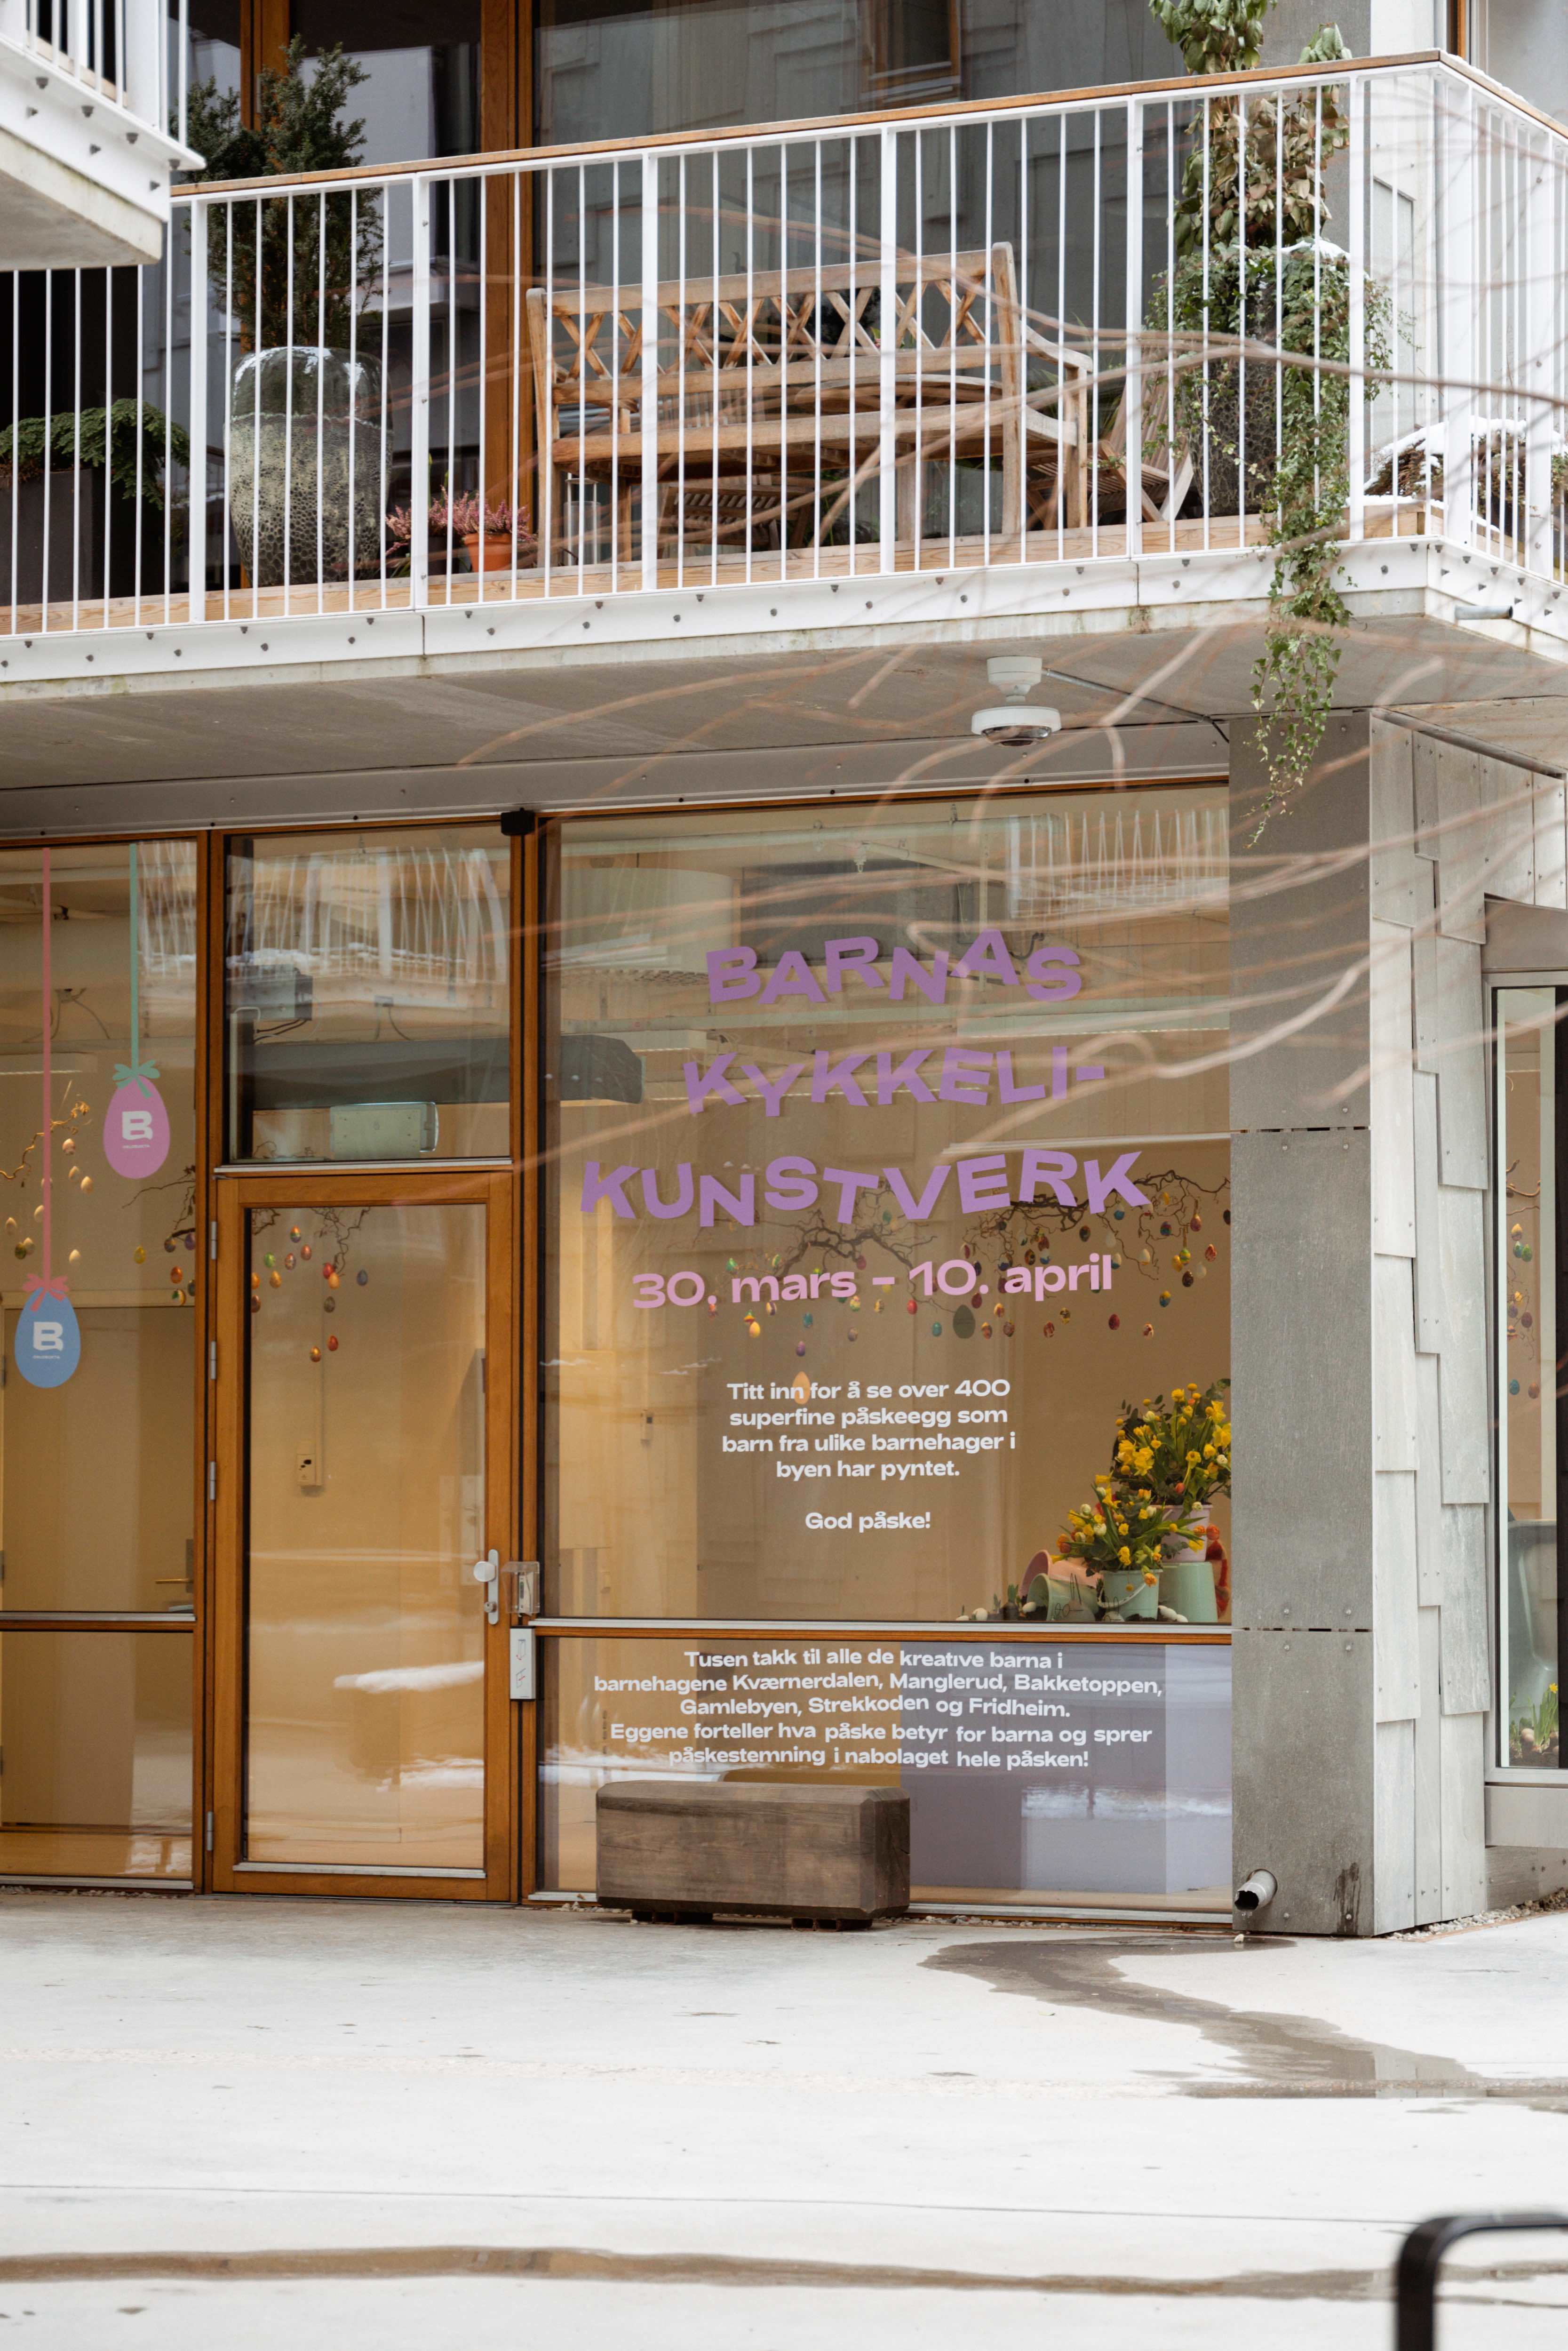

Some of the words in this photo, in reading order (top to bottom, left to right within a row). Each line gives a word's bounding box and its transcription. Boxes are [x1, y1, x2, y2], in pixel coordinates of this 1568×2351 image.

[705, 928, 1082, 1005] BARNAS
[683, 1046, 1105, 1116] KYKKELI-
[121, 1111, 153, 1140] B
[580, 1149, 1153, 1226] KUNSTVERK
[632, 1272, 716, 1309] 30.
[732, 1268, 857, 1303] mars
[908, 1259, 989, 1297] 10.
[1003, 1254, 1113, 1301] april
[32, 1321, 64, 1351] B
[727, 1383, 764, 1399] Titt
[771, 1382, 804, 1399] inn
[810, 1382, 841, 1399] for
[847, 1381, 860, 1399] å
[867, 1384, 892, 1398] se
[899, 1383, 949, 1398] over
[955, 1379, 1011, 1397] 400
[730, 1408, 835, 1430] superfine
[842, 1407, 951, 1428] påskeegg
[957, 1409, 1007, 1423] som
[722, 1436, 772, 1452] barn
[779, 1436, 809, 1452] fra
[814, 1433, 866, 1452] ulike
[872, 1432, 1004, 1454] barnehager
[1010, 1431, 1015, 1449] i
[777, 1461, 831, 1481] byen
[837, 1461, 875, 1477] har
[881, 1461, 960, 1480] pyntet.
[805, 1512, 852, 1529] God
[859, 1511, 931, 1533] påske!
[685, 1651, 748, 1667] Tusen
[753, 1649, 797, 1666] takk
[803, 1648, 820, 1664] til
[827, 1648, 862, 1664] alle
[868, 1648, 893, 1664] de
[990, 1652, 1051, 1668] barna
[1058, 1652, 1063, 1668] i
[594, 1676, 727, 1695] barnehagene
[733, 1672, 883, 1690] Kværnerdalen,
[890, 1674, 1007, 1693] Manglerud,
[1015, 1674, 1162, 1696] Bakketoppen,
[680, 1699, 803, 1717] Gamlebyen,
[808, 1695, 929, 1713] Strekkoden
[936, 1703, 963, 1717] og
[969, 1698, 1070, 1717] Fridheim.
[611, 1724, 688, 1742] Eggene
[693, 1723, 773, 1739] forteller
[779, 1723, 816, 1738] hva
[825, 1723, 886, 1743] påske
[892, 1724, 948, 1743] betyr
[956, 1726, 986, 1742] for
[992, 1727, 1053, 1743] barna
[1059, 1731, 1086, 1746] og
[1093, 1728, 1152, 1745] sprer
[669, 1746, 825, 1766] påskestemning
[834, 1747, 839, 1763] i
[845, 1748, 948, 1768] nabolaget
[957, 1751, 1001, 1767] hele
[1007, 1751, 1089, 1771] påsken!
